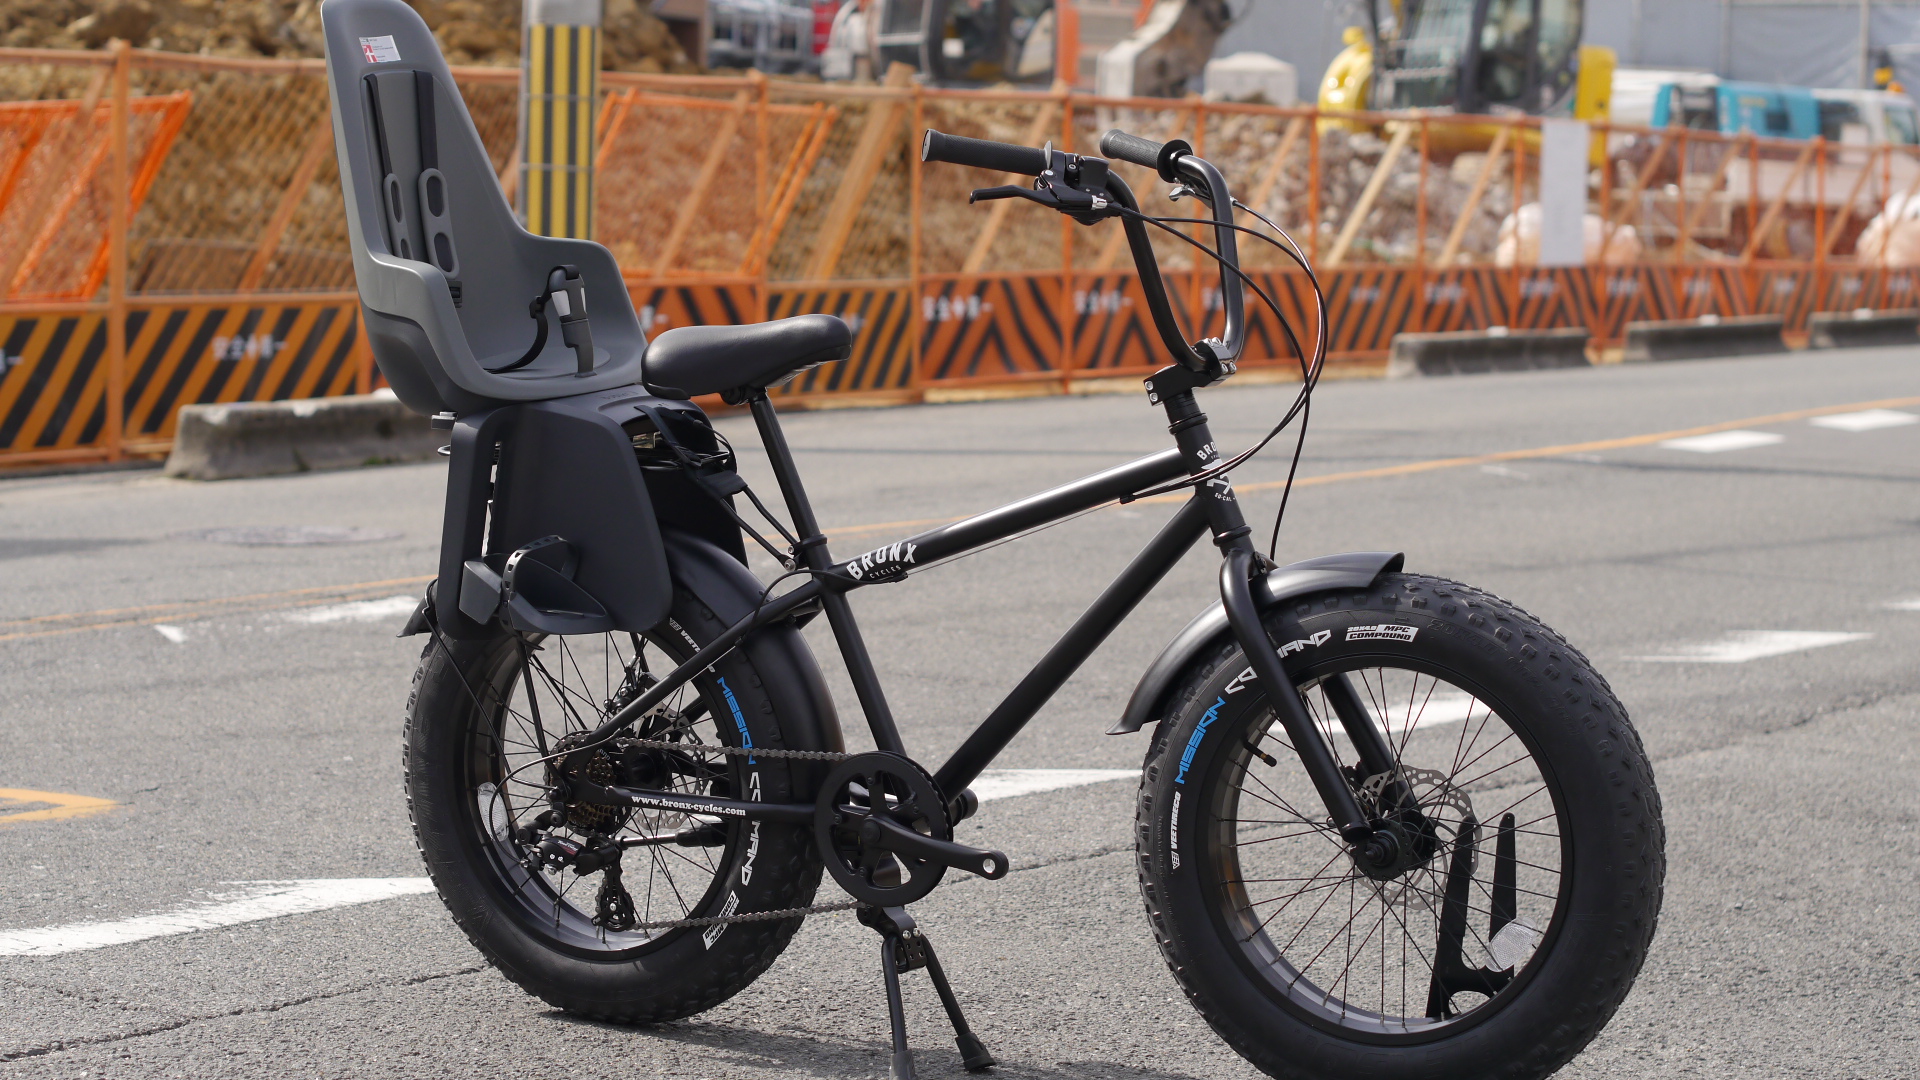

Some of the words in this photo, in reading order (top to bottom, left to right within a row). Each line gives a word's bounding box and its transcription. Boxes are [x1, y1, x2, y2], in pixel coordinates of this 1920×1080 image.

[1197, 442, 1217, 460] BRO
[846, 542, 917, 580] BRONX
[869, 565, 901, 579] CYCLES
[1349, 632, 1412, 641] COMPOUND
[1383, 625, 1411, 633] MPC
[1175, 696, 1226, 784] MISSION
[631, 795, 746, 816] www.bronx-cycles.com
